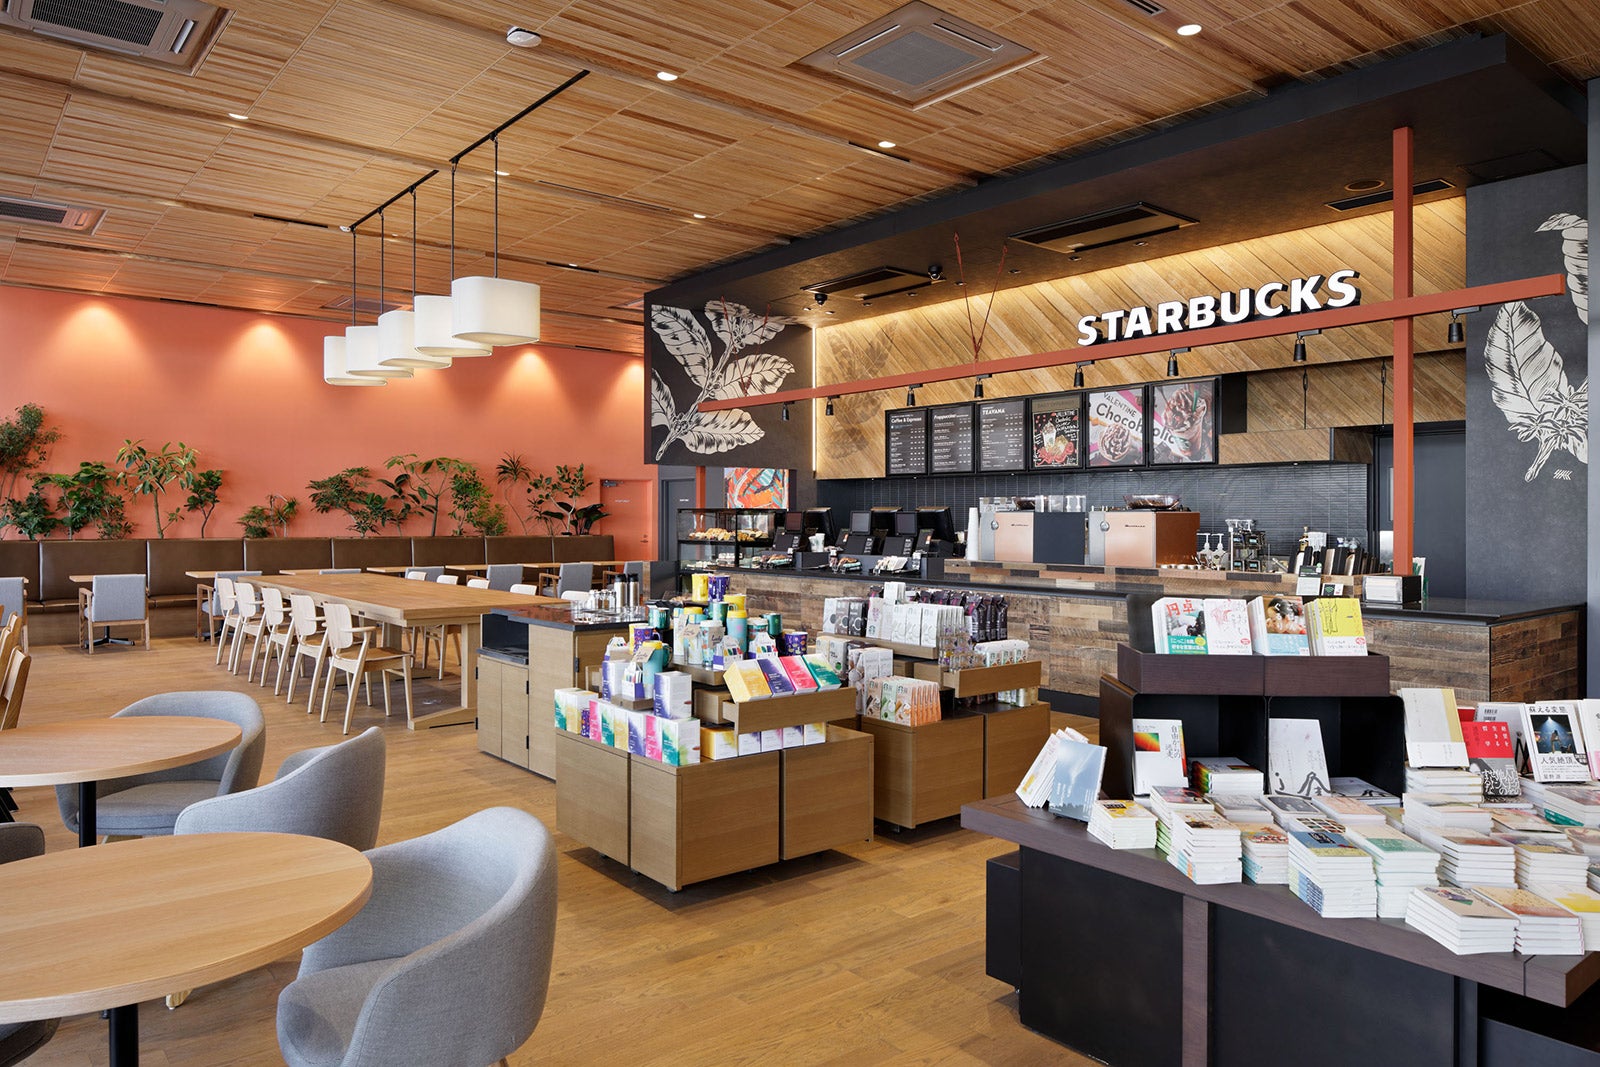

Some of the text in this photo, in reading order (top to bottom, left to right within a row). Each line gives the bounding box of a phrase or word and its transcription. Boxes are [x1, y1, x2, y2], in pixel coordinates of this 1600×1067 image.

[1077, 269, 1360, 346] STARBUCKS
[1104, 392, 1137, 417] VALENTINE
[1166, 599, 1195, 617] 円卓
